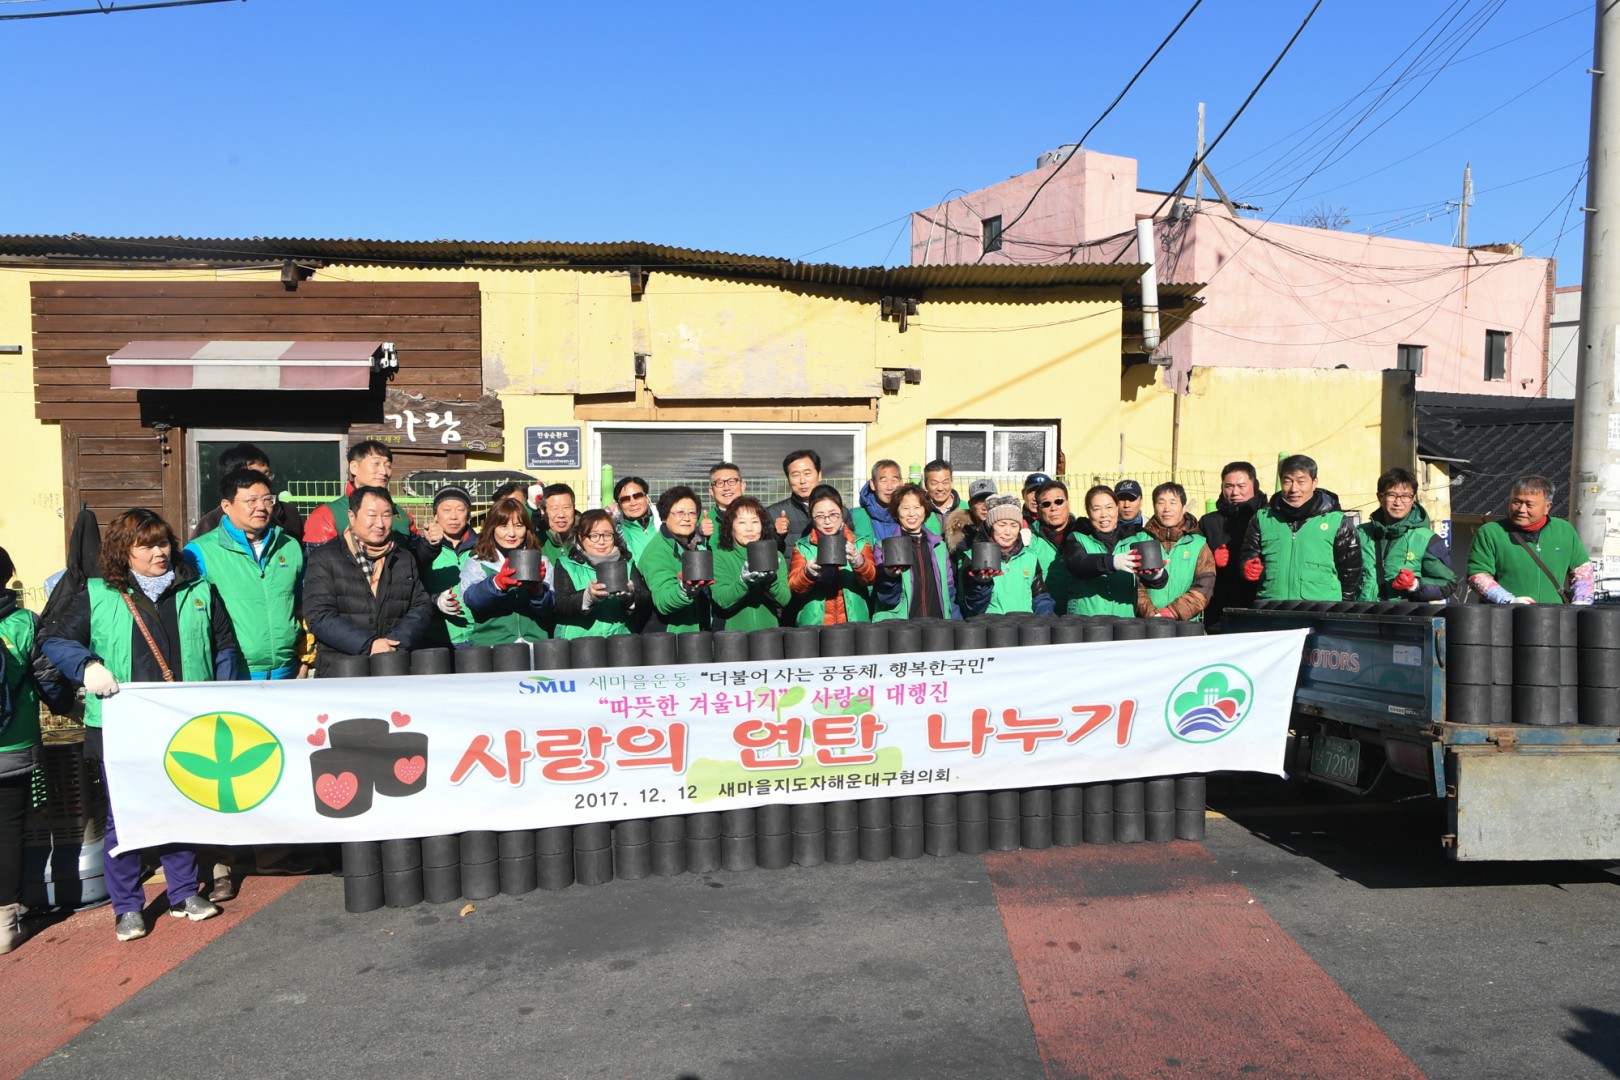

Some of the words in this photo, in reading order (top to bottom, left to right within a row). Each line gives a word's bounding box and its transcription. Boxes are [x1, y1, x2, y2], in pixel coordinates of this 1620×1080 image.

[384, 410, 461, 444] 가람
[537, 441, 570, 457] 69
[588, 673, 690, 691] 새마을운동
[774, 668, 815, 684] 사는
[819, 664, 883, 681] 공동체,
[890, 657, 995, 678] 행복한국민”
[811, 684, 875, 709] 사랑의
[886, 681, 948, 705] 대행진
[449, 722, 687, 785] 사랑의
[732, 713, 885, 768] 연탄
[926, 699, 1136, 755] 나누기
[1326, 751, 1356, 778] 7209
[574, 792, 627, 809] 2017.
[639, 788, 666, 803] 12.
[678, 785, 698, 799] 12
[718, 768, 950, 797] 새마을지도자해운대구협의회
